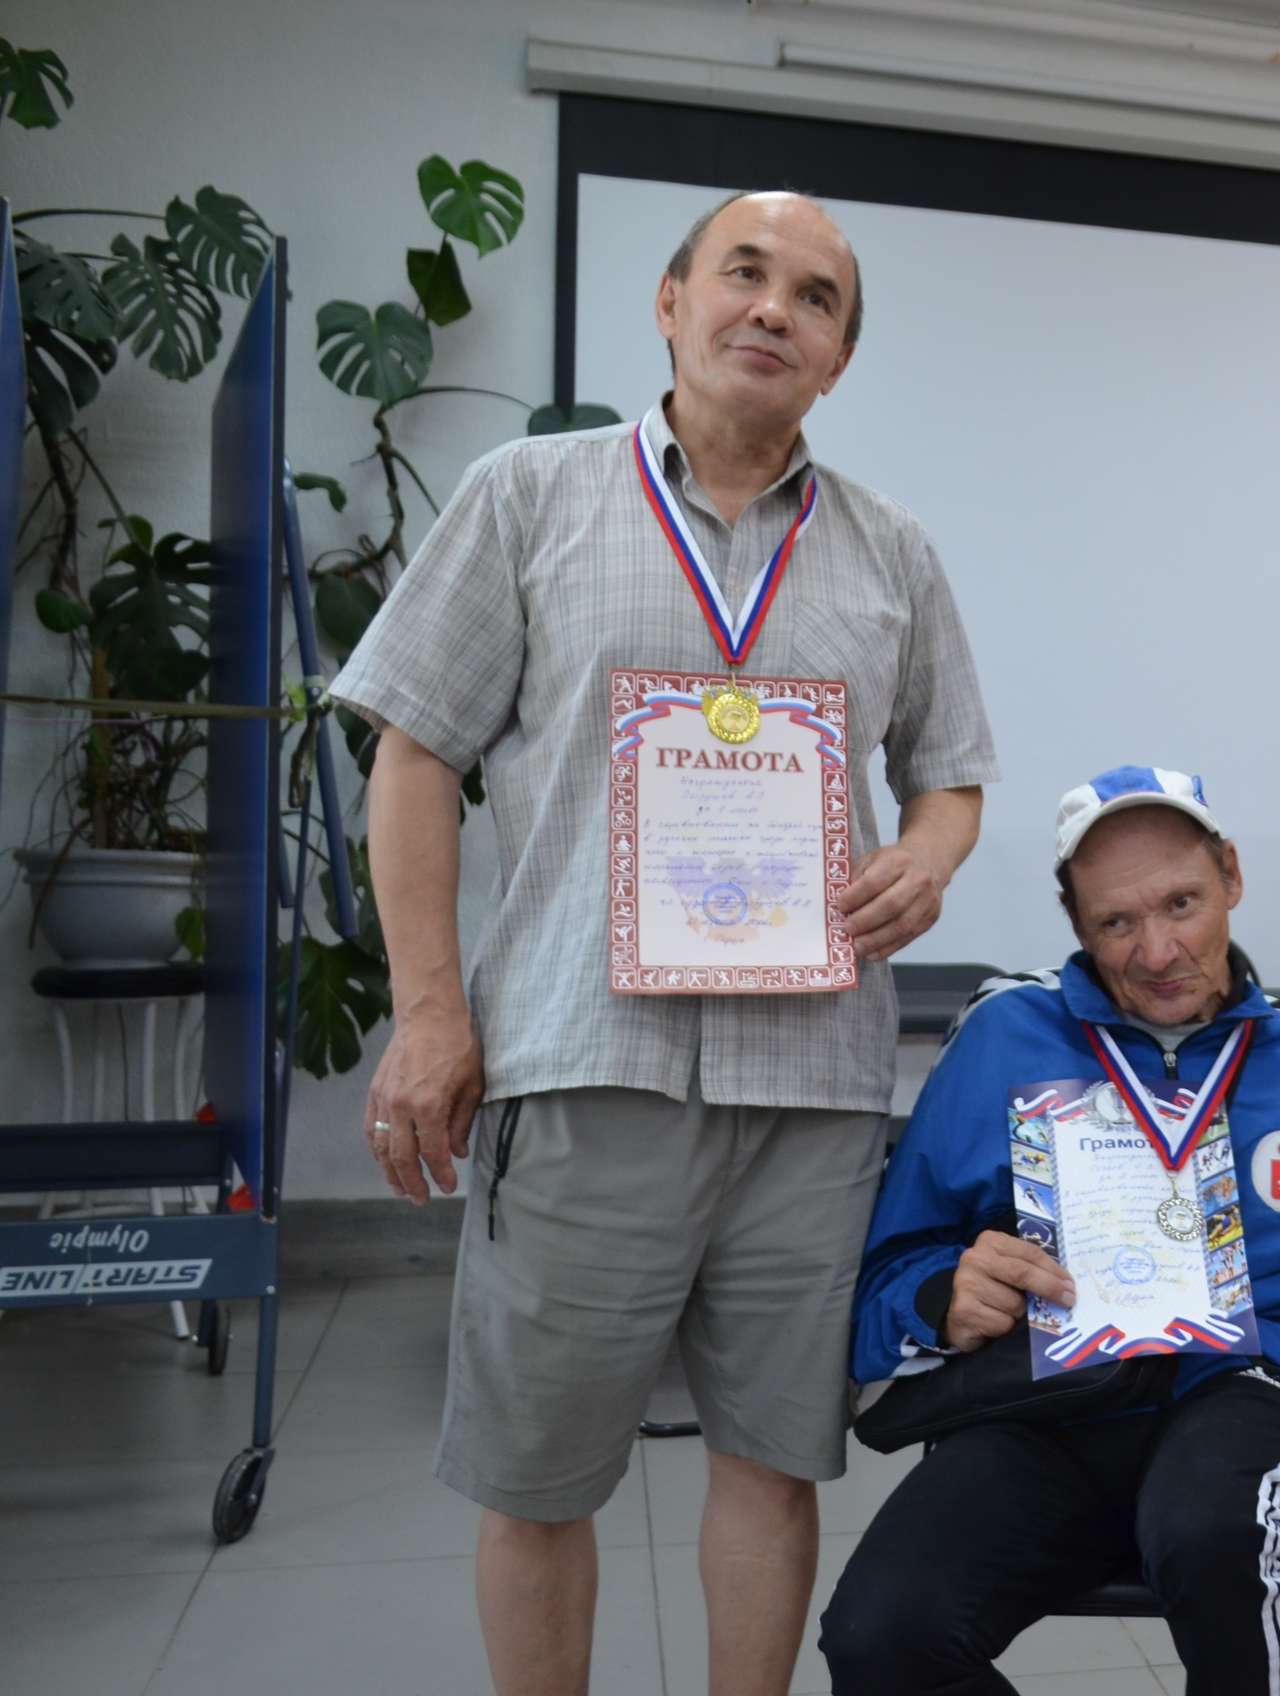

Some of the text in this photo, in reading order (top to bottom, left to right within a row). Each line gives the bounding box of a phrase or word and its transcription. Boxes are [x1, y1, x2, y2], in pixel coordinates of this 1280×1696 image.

[655, 746, 805, 773] ГРАМОТА
[50, 1224, 150, 1254] Olympic
[0, 1263, 203, 1293] START LINE
